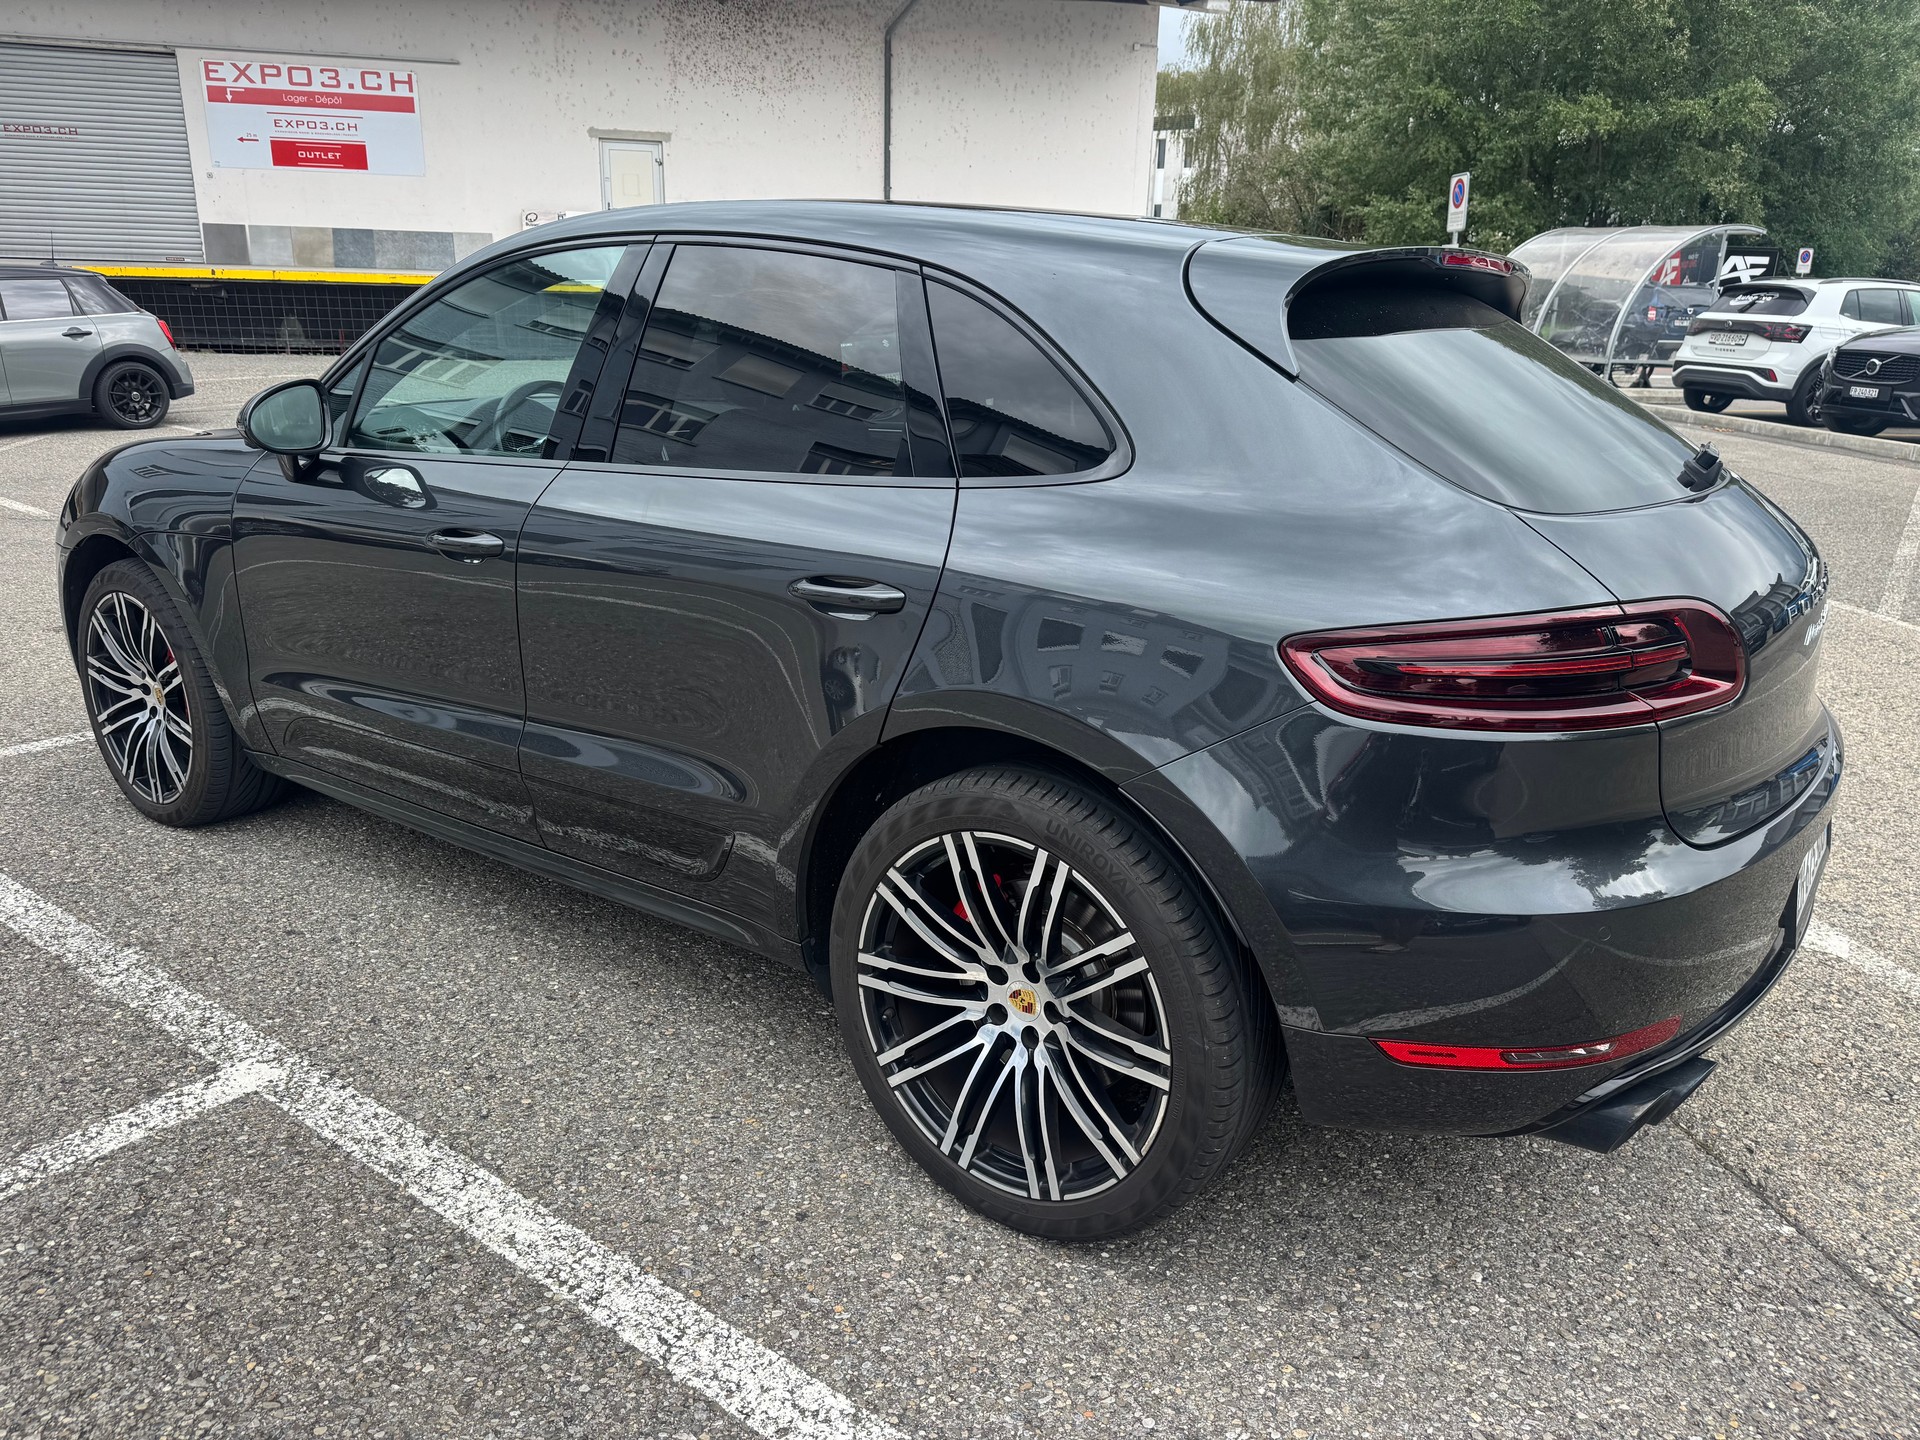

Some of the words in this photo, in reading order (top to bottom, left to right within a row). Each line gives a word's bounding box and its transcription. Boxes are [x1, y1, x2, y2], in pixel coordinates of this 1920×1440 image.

[203, 60, 414, 93] EXPO3.CH
[282, 93, 308, 105] Lager
[315, 95, 343, 106] Dépôt
[3, 123, 79, 136] EXPO3.CH
[273, 118, 358, 132] EXPO3.CH
[297, 150, 342, 160] OUTLET
[1045, 818, 1137, 898] UNIROYAL
